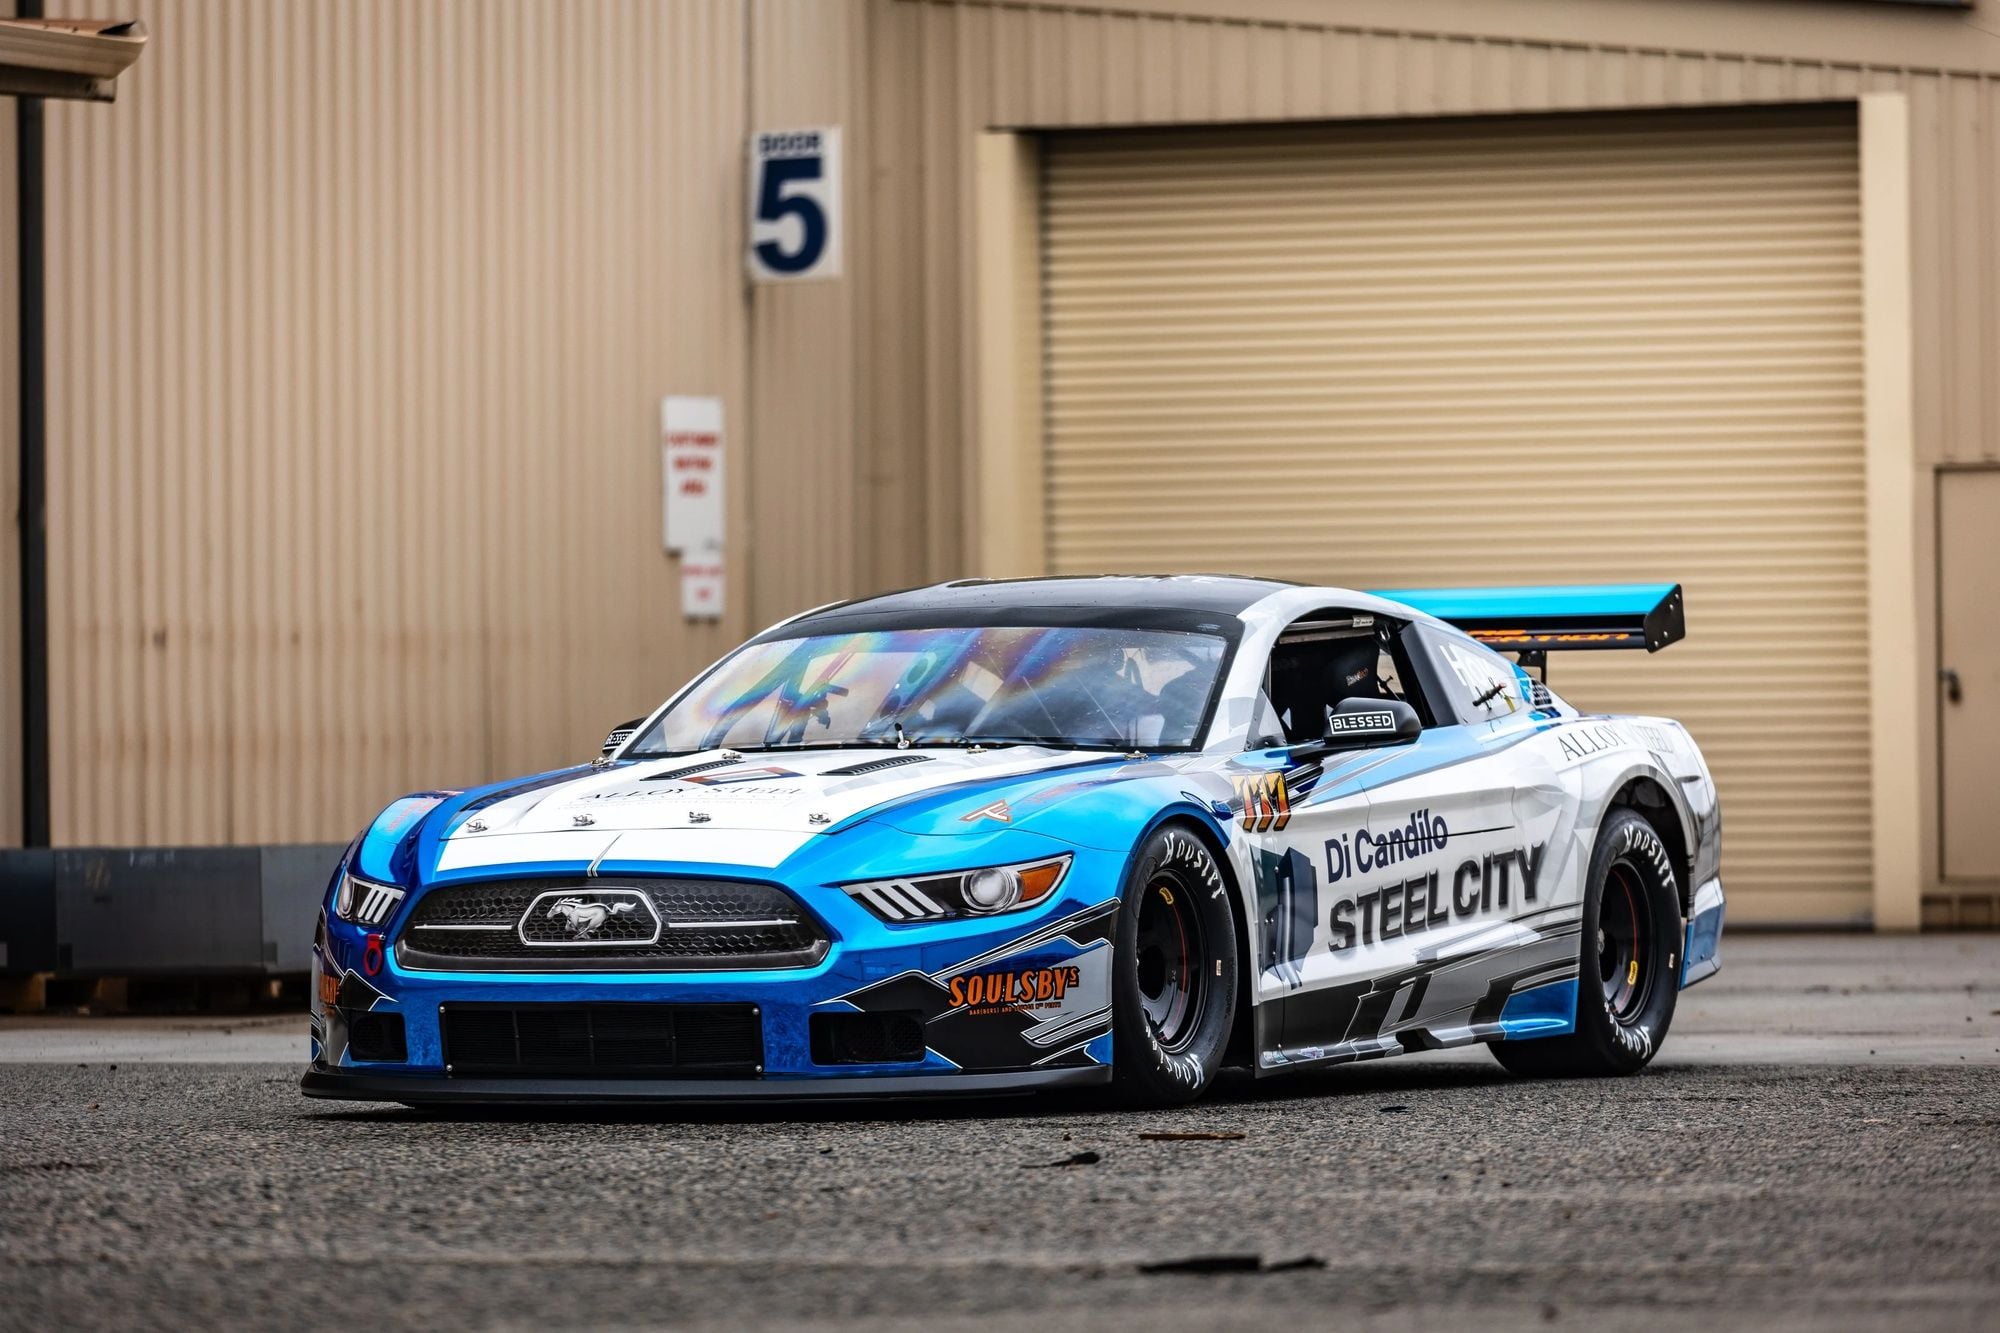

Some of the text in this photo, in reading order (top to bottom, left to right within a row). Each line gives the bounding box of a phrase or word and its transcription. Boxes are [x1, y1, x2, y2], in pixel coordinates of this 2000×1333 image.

[754, 157, 828, 274] 5
[1333, 715, 1392, 729] BLESSED
[1558, 724, 1627, 761] ALLOY
[1325, 808, 1449, 884] Di Candilo
[1328, 840, 1547, 952] STEEL CITY
